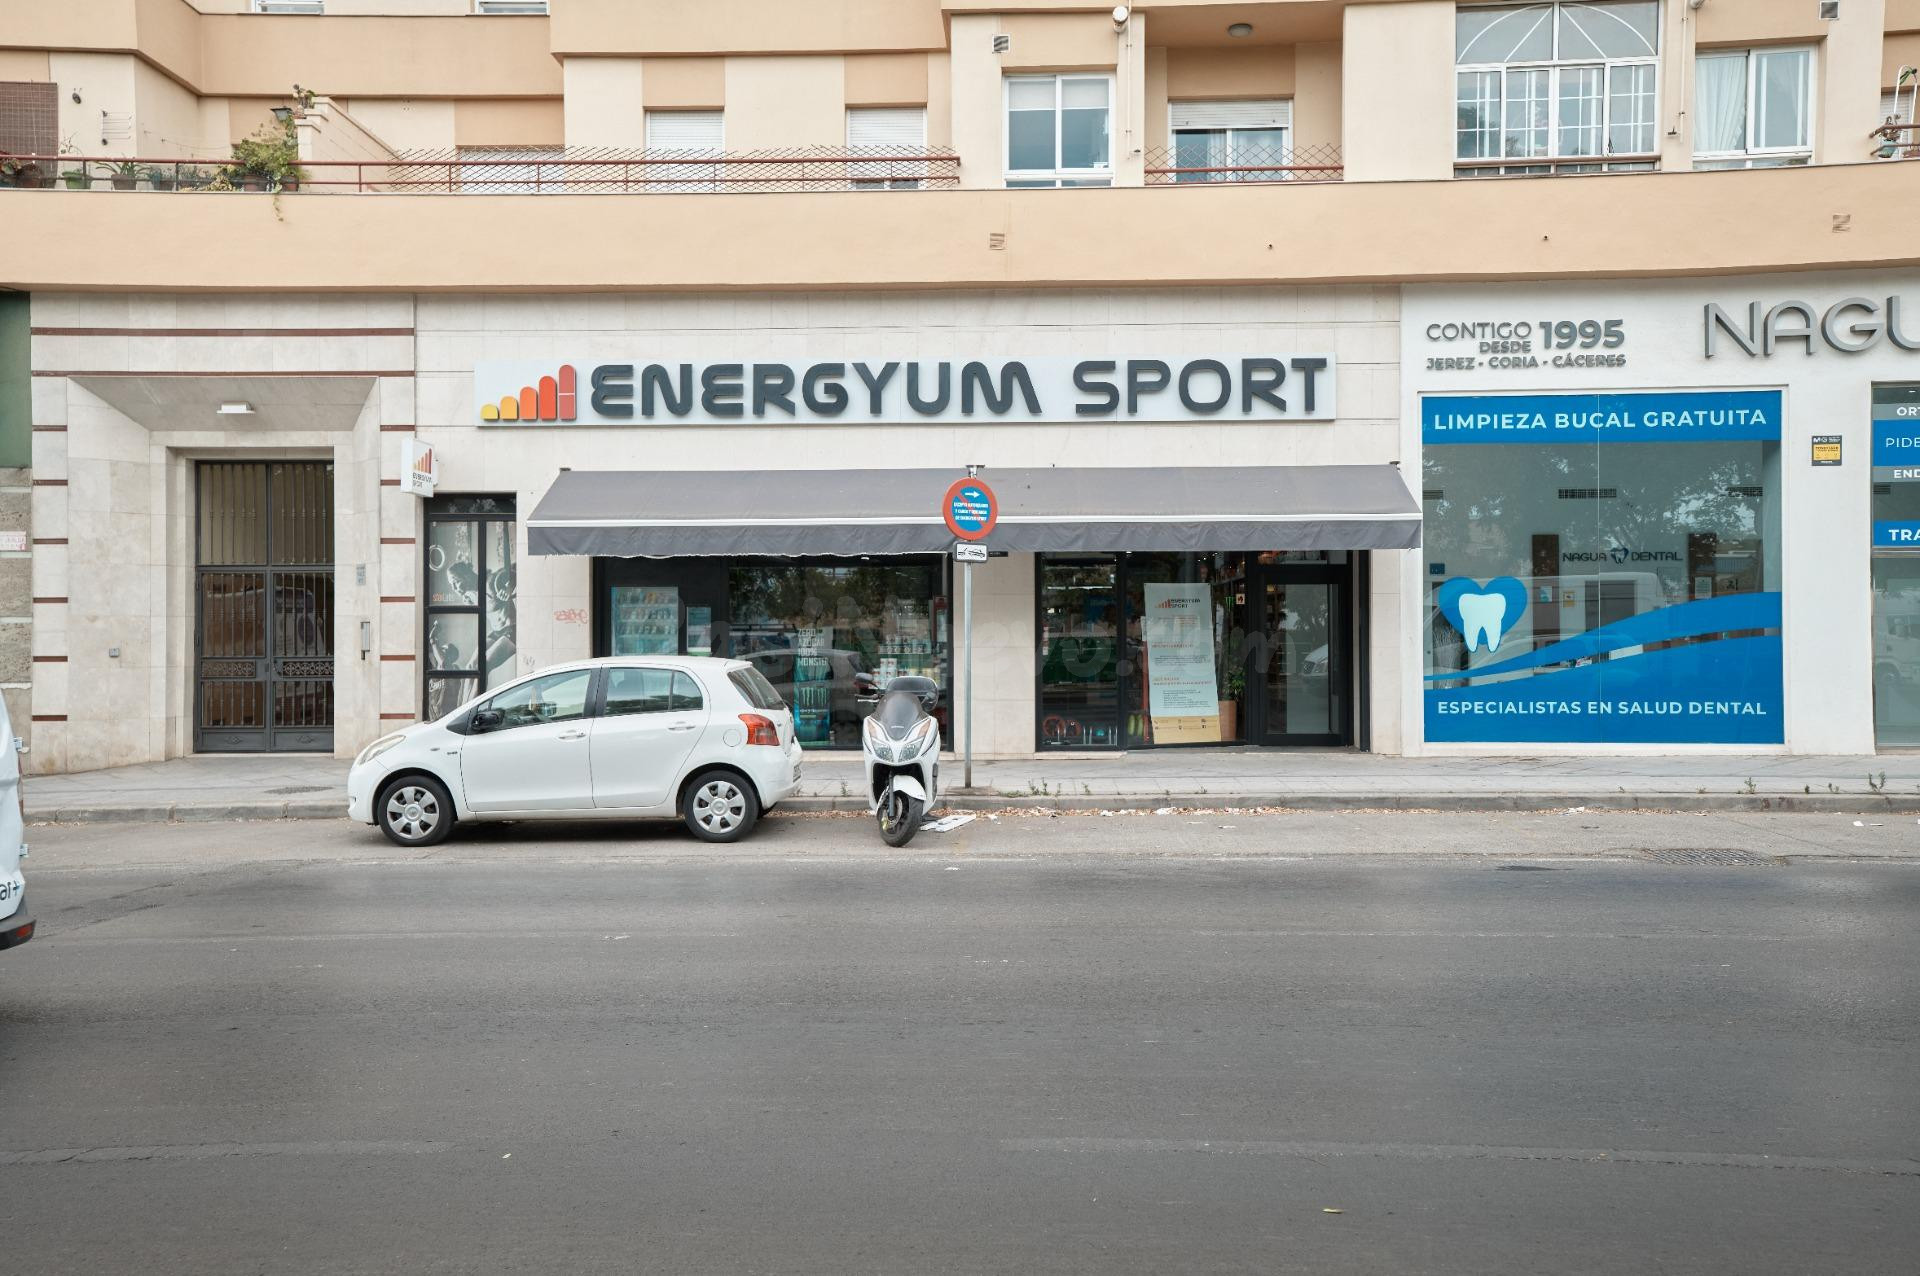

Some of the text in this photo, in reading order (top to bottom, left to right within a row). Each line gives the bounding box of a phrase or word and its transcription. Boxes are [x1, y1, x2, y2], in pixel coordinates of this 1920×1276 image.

[1426, 318, 1625, 350] CONTIGO 1995
[1704, 295, 1920, 358] NAGU
[1479, 340, 1532, 354] DESDE
[1426, 357, 1476, 370] JEREZ
[1488, 355, 1539, 369] CORIA
[1552, 352, 1627, 368] CÁCERES
[591, 357, 1328, 418] ENERGYUM SPORT
[1896, 406, 1920, 416] OR
[1434, 408, 1767, 431] LIMPIEZA BUCAL GRATUITA
[1885, 437, 1920, 448] PIDE
[1562, 551, 1684, 562] NAGUA DENTAL
[798, 628, 817, 637] ZERO
[798, 647, 818, 657] 100%
[1437, 700, 1767, 716] ESPECIALISTAS EN SALUD DENTAL
